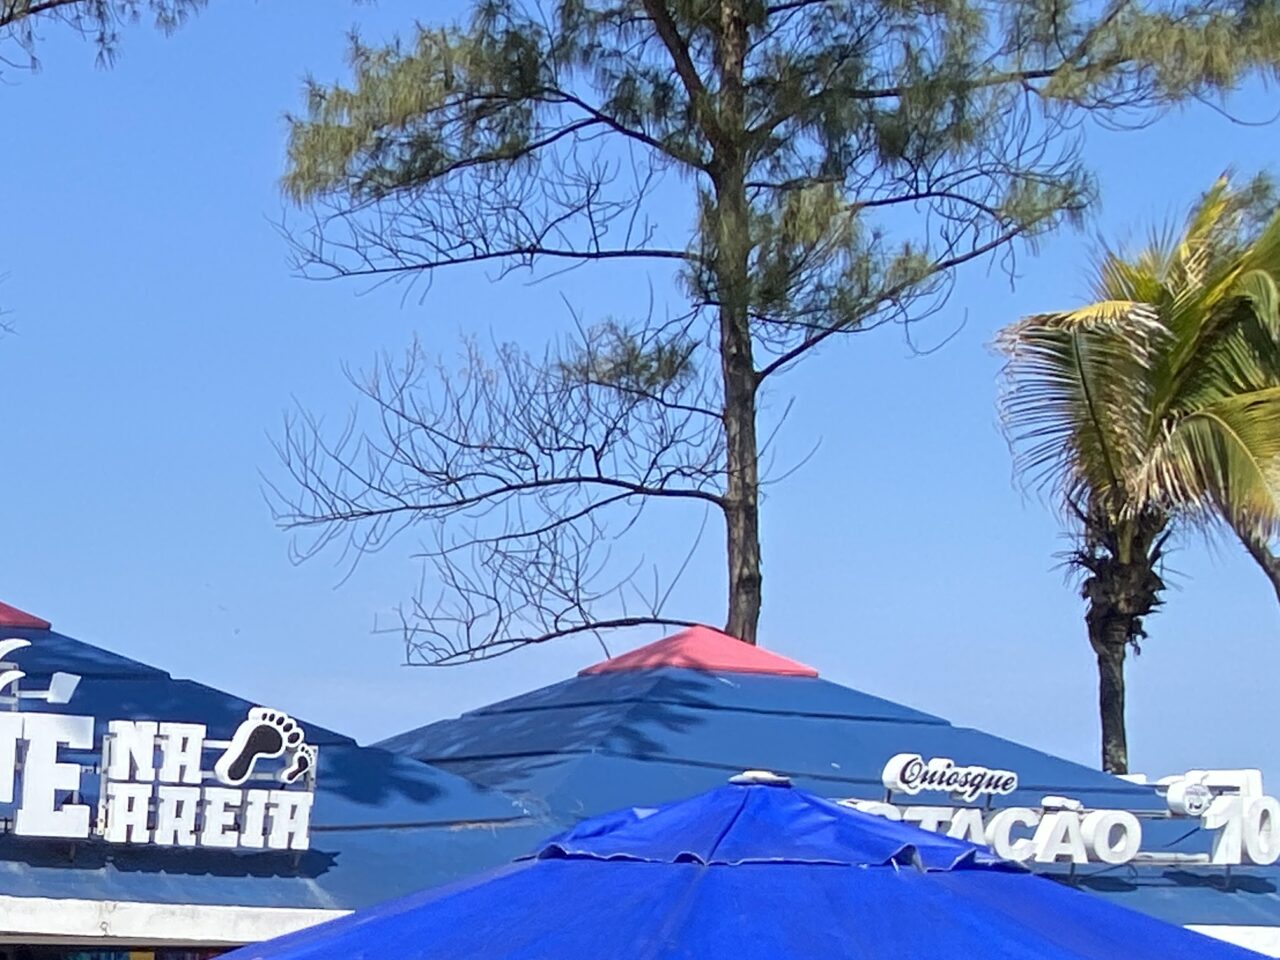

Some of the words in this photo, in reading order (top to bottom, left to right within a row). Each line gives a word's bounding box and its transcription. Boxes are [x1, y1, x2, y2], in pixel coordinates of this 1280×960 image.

[108, 719, 208, 784] NA
[898, 756, 1018, 800] Quiosque
[103, 782, 316, 851] AREIA
